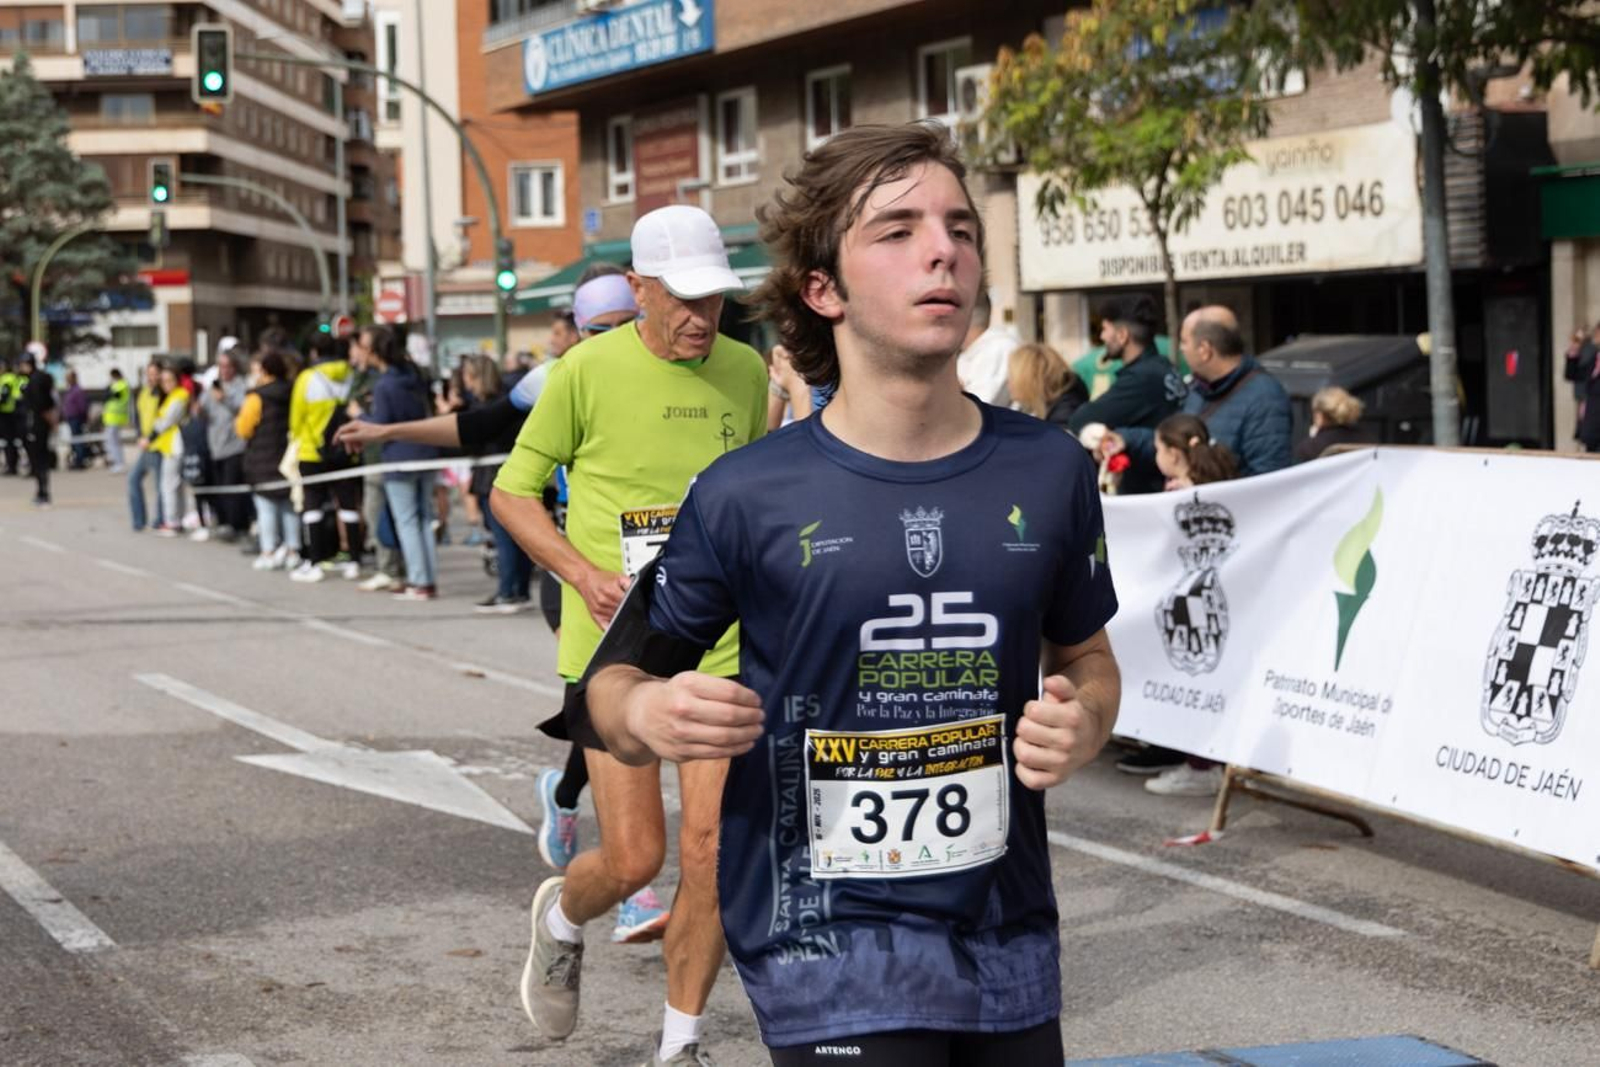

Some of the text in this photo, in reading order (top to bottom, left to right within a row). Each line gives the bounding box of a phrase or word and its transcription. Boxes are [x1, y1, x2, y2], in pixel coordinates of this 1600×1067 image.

[1223, 181, 1385, 230] 603 045 046
[859, 592, 999, 651] 25
[857, 650, 997, 670] CARRERA
[858, 669, 999, 689] POPULAR
[784, 695, 821, 723] IES
[858, 688, 999, 704] y gran caminata
[1143, 680, 1184, 706] CIUDAD
[1185, 688, 1201, 710] DE
[1320, 680, 1380, 712] Municipal
[856, 702, 877, 718] Por
[879, 703, 890, 718] la
[894, 704, 912, 720] Paz
[925, 705, 936, 719] la
[1328, 709, 1344, 730] de
[813, 724, 997, 763] XXV CARRERA POPULAR
[877, 749, 919, 765] gran
[927, 736, 997, 758] caminata
[835, 765, 856, 778] POR
[857, 765, 873, 778] LA
[906, 764, 923, 777] LA
[1436, 745, 1583, 801] CIUDAD DE JAÉN
[778, 732, 801, 847] CATALINA
[850, 783, 971, 844] 378
